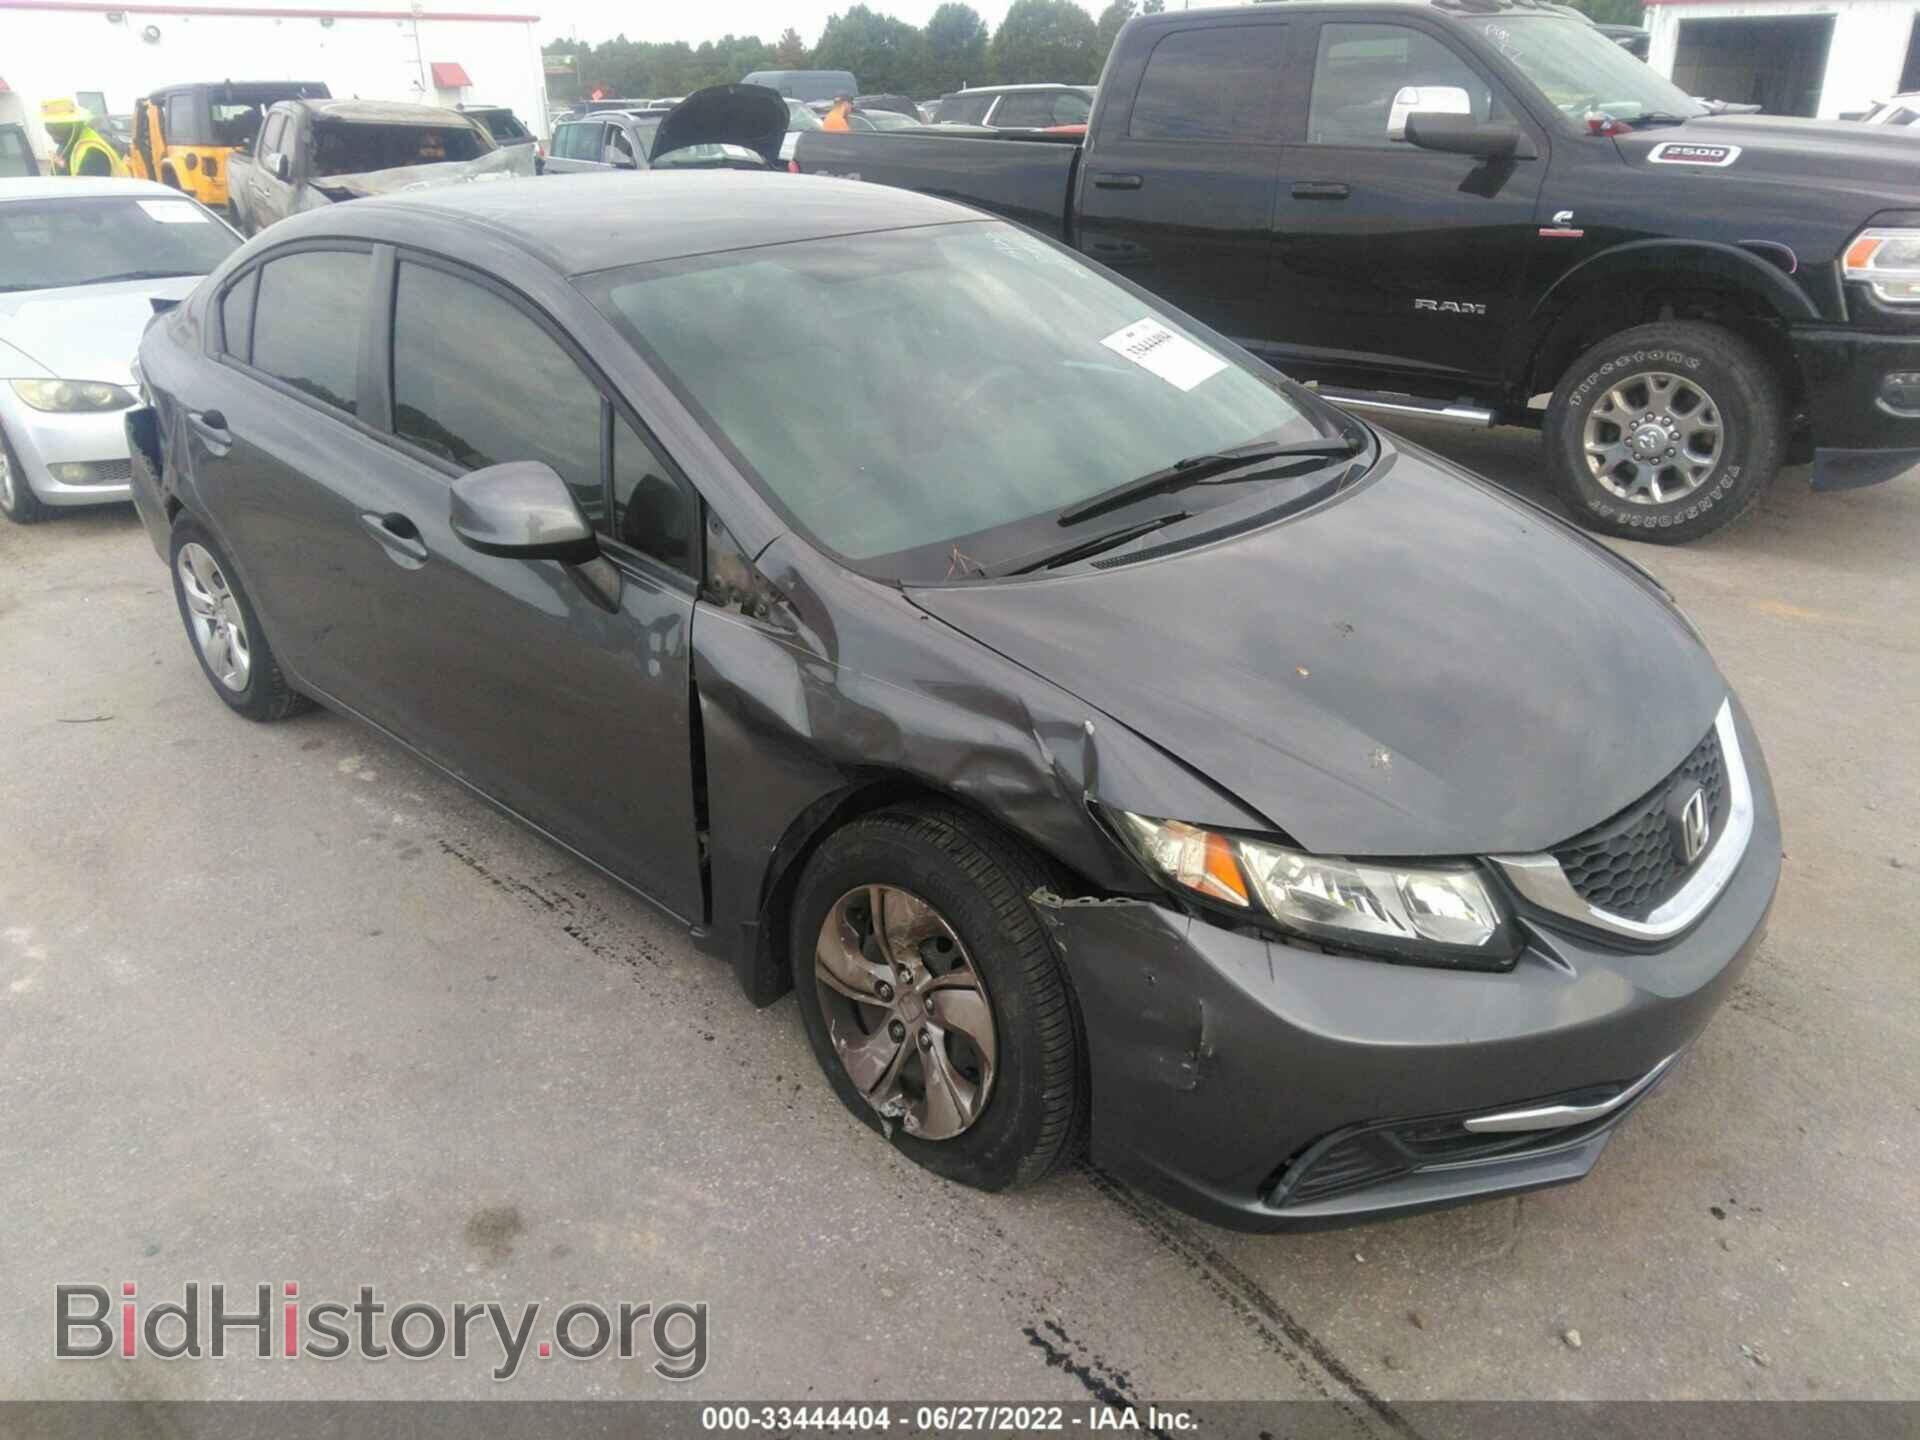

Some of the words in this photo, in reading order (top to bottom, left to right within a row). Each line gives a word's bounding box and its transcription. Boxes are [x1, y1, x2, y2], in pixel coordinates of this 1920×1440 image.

[1666, 146, 1726, 157] 2500
[1415, 298, 1486, 314] RAM
[1617, 464, 1741, 528] TRANSFORCE
